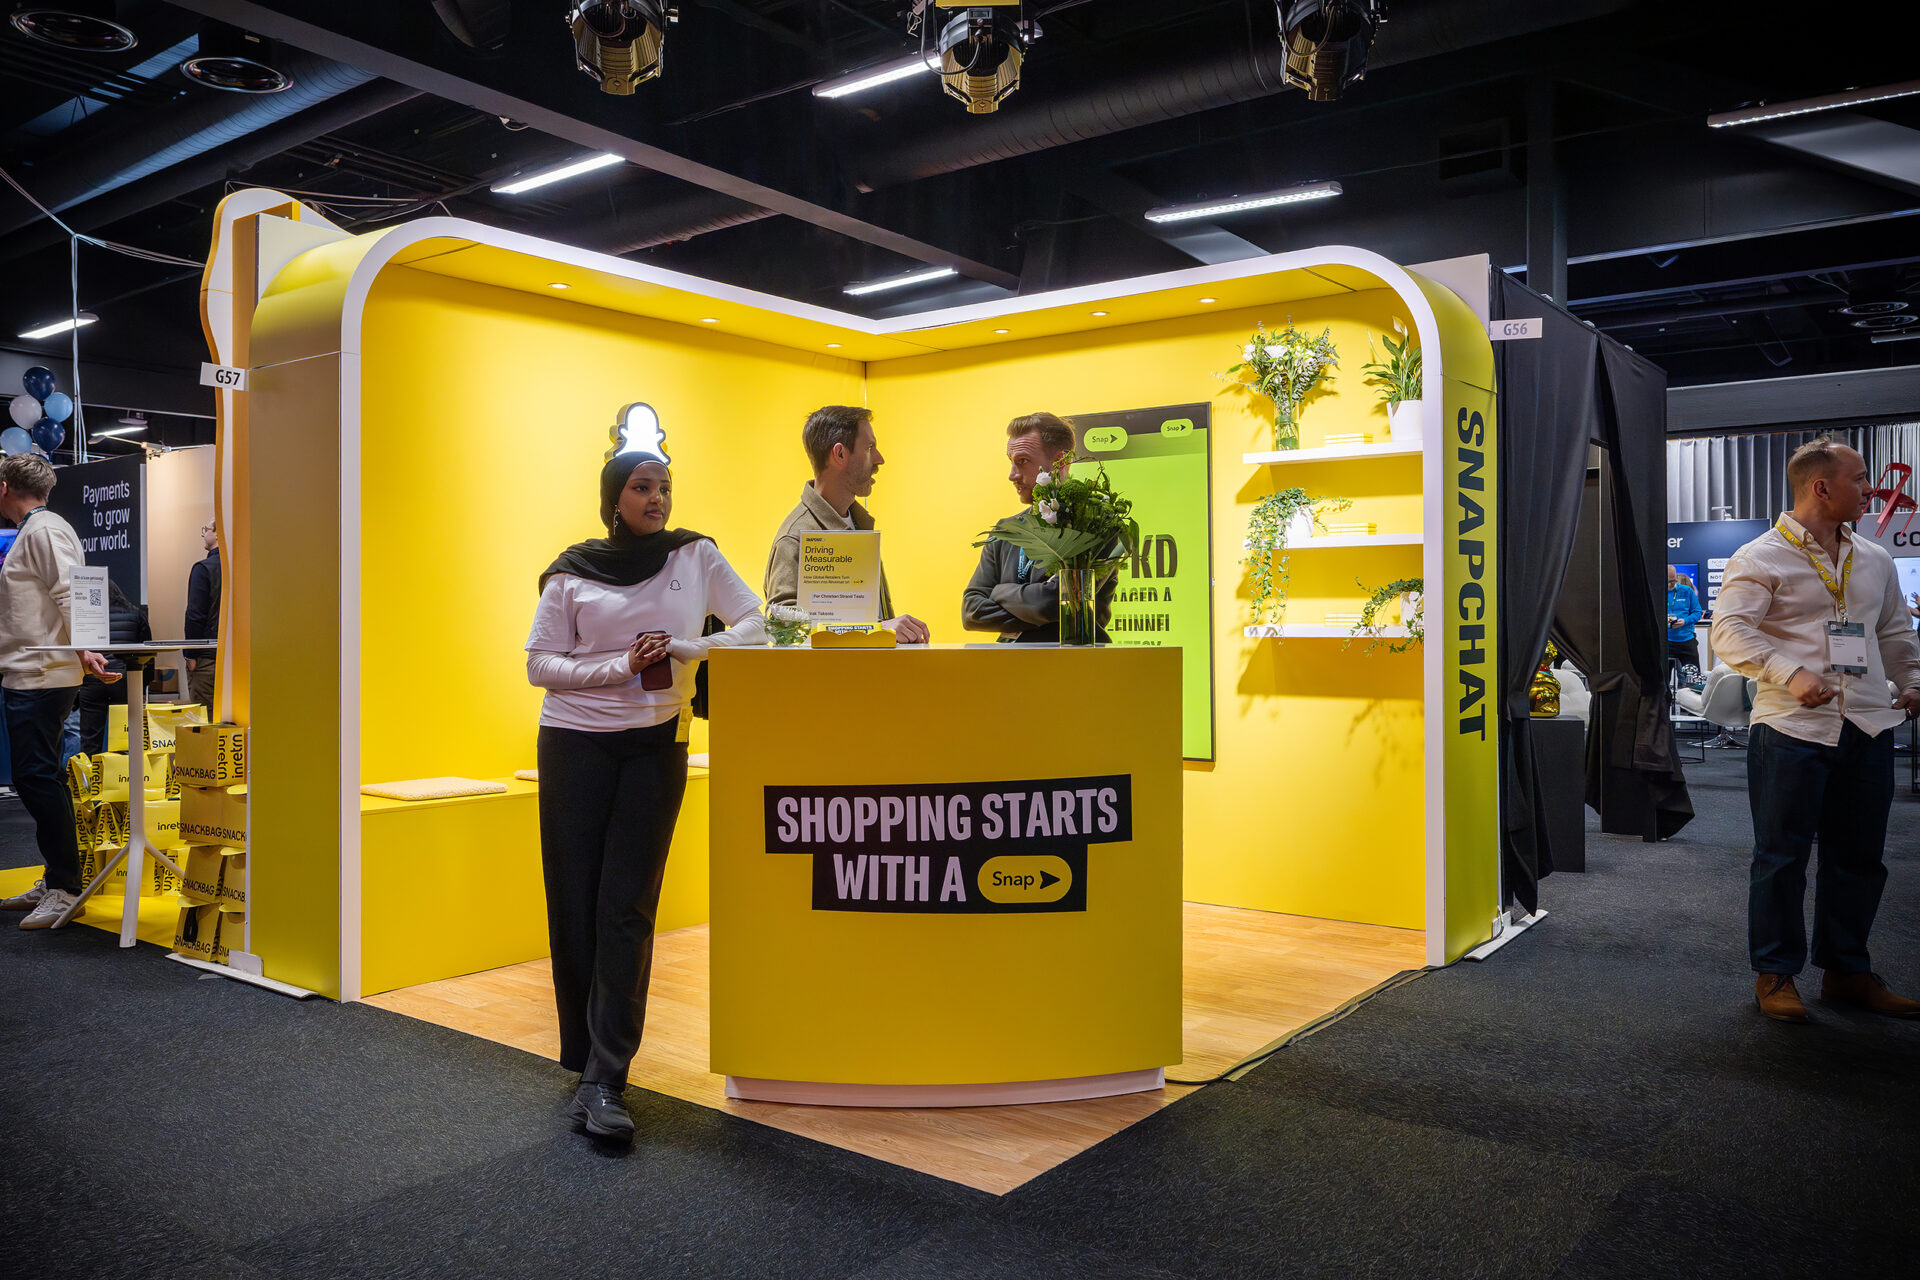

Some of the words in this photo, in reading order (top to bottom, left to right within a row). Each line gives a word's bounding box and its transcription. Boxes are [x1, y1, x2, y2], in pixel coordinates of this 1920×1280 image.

[1504, 323, 1528, 336] G56
[216, 369, 241, 386] G57
[1092, 435, 1109, 444] Snap
[83, 480, 130, 507] Payments
[93, 509, 103, 527] to
[105, 507, 130, 531] grow
[80, 537, 98, 552] our
[100, 529, 130, 551] world.
[1667, 537, 1683, 548] er
[805, 545, 834, 556] Driving
[804, 555, 853, 563] Measurable
[804, 563, 835, 572] Growth
[1457, 406, 1486, 742] SNAPCHAT
[218, 735, 228, 780] inretrn
[231, 733, 243, 779] inretrn
[91, 761, 103, 796] inretrn
[176, 766, 217, 780] SNACKBAG
[777, 794, 972, 843] SHOPPING
[982, 787, 1118, 839] STARTS
[157, 822, 180, 831] inret
[180, 823, 222, 837] SNACKBAG
[222, 829, 246, 841] SNACK
[833, 854, 930, 902] WITH
[940, 856, 967, 902] A
[992, 871, 1035, 889] Snap
[182, 878, 215, 896] SNACKBAG
[222, 886, 246, 902] SNACKB
